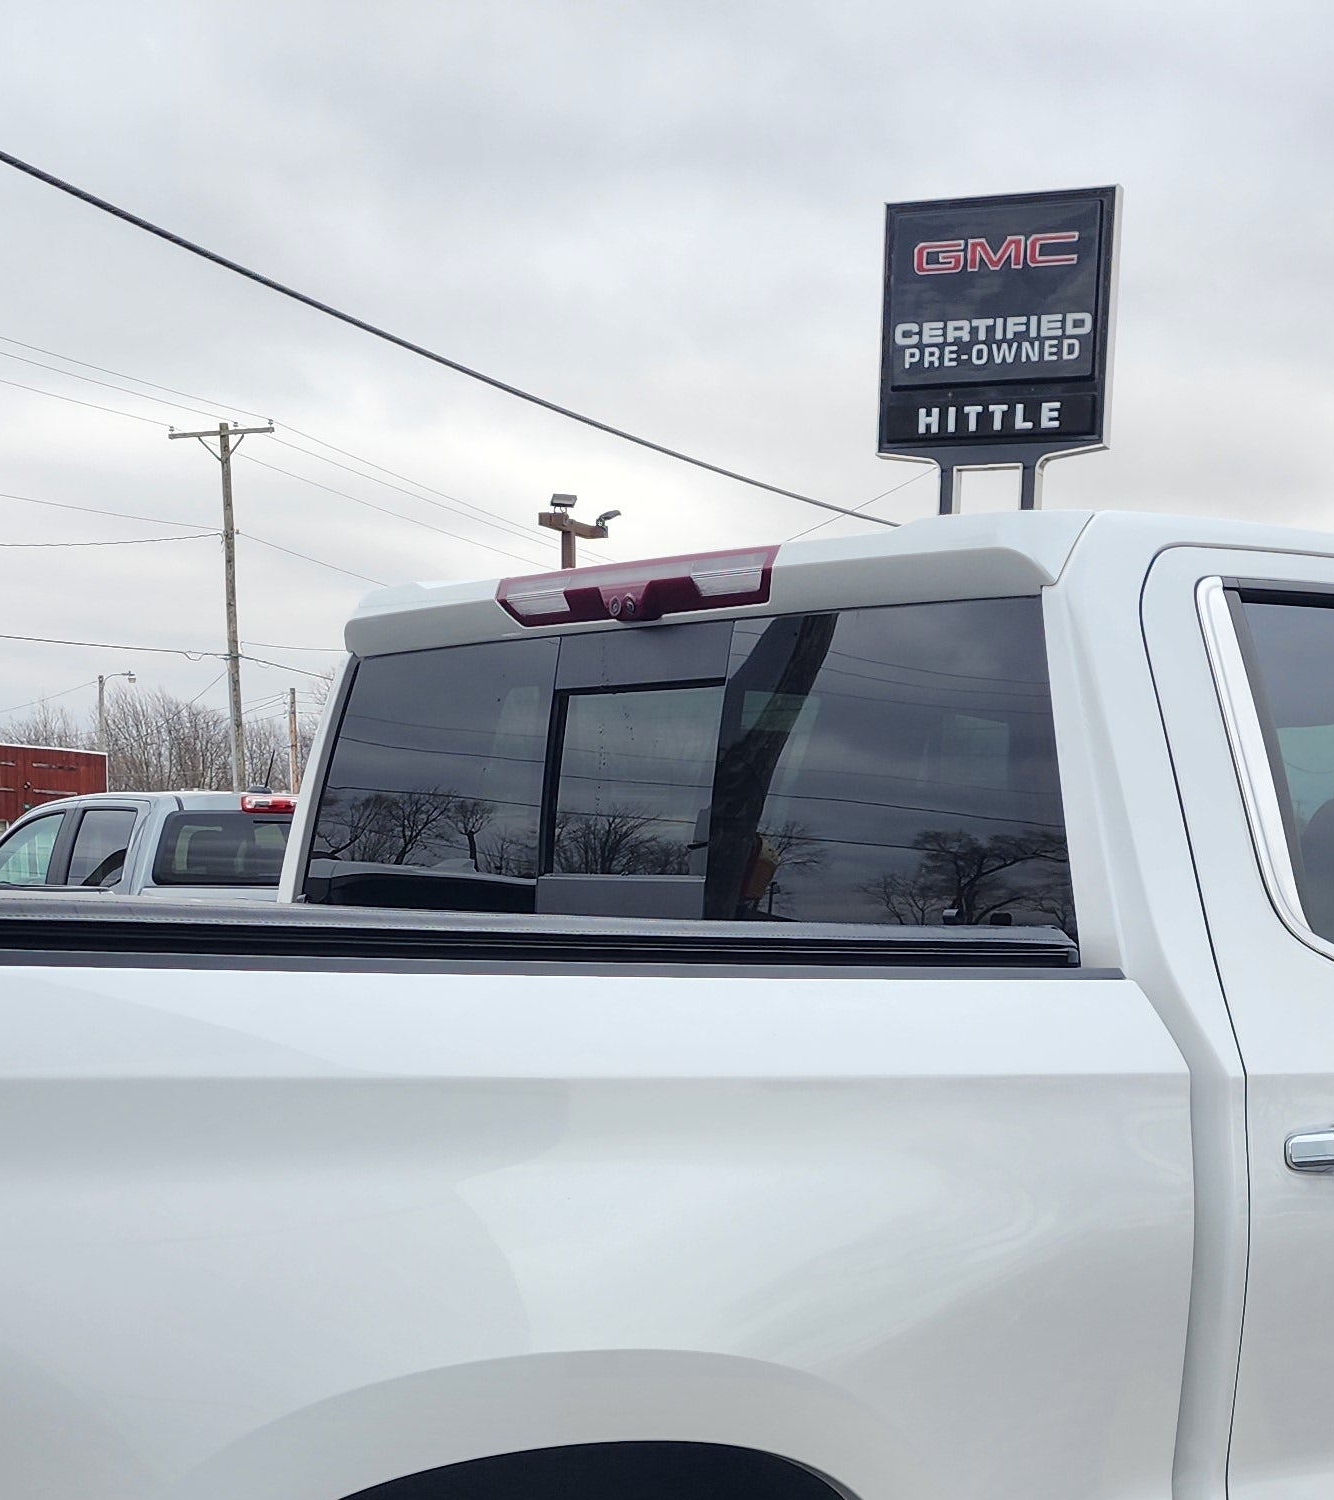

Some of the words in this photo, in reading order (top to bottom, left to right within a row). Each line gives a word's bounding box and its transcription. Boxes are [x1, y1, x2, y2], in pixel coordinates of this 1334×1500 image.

[914, 231, 1080, 275] GMC
[894, 312, 1093, 346] CERTIFIED
[904, 338, 1081, 369] PRE-OWNED
[918, 402, 1062, 434] HITTLE
